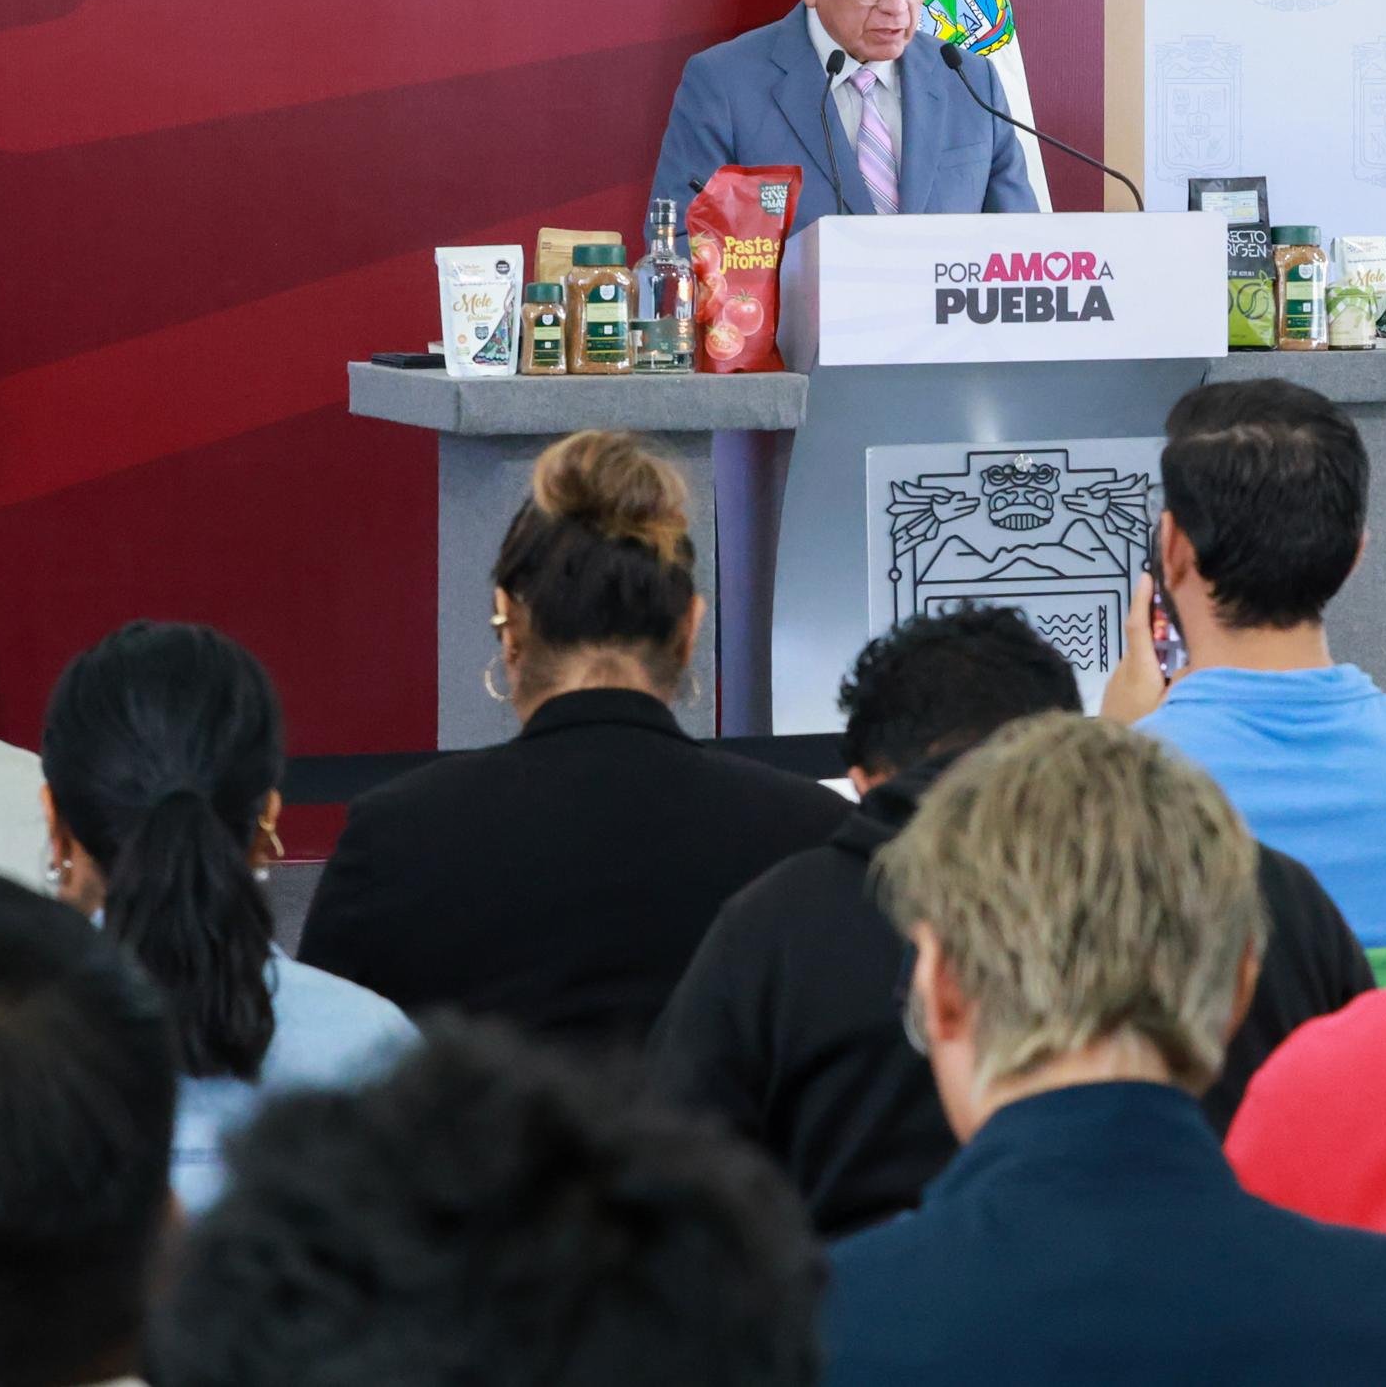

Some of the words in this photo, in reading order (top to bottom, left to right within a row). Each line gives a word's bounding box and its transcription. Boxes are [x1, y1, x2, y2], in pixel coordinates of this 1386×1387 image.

[1227, 230, 1267, 243] ECTO
[724, 236, 773, 254] Pasta
[1226, 243, 1267, 258] RIGEN
[935, 285, 1115, 324] PUEBLA
